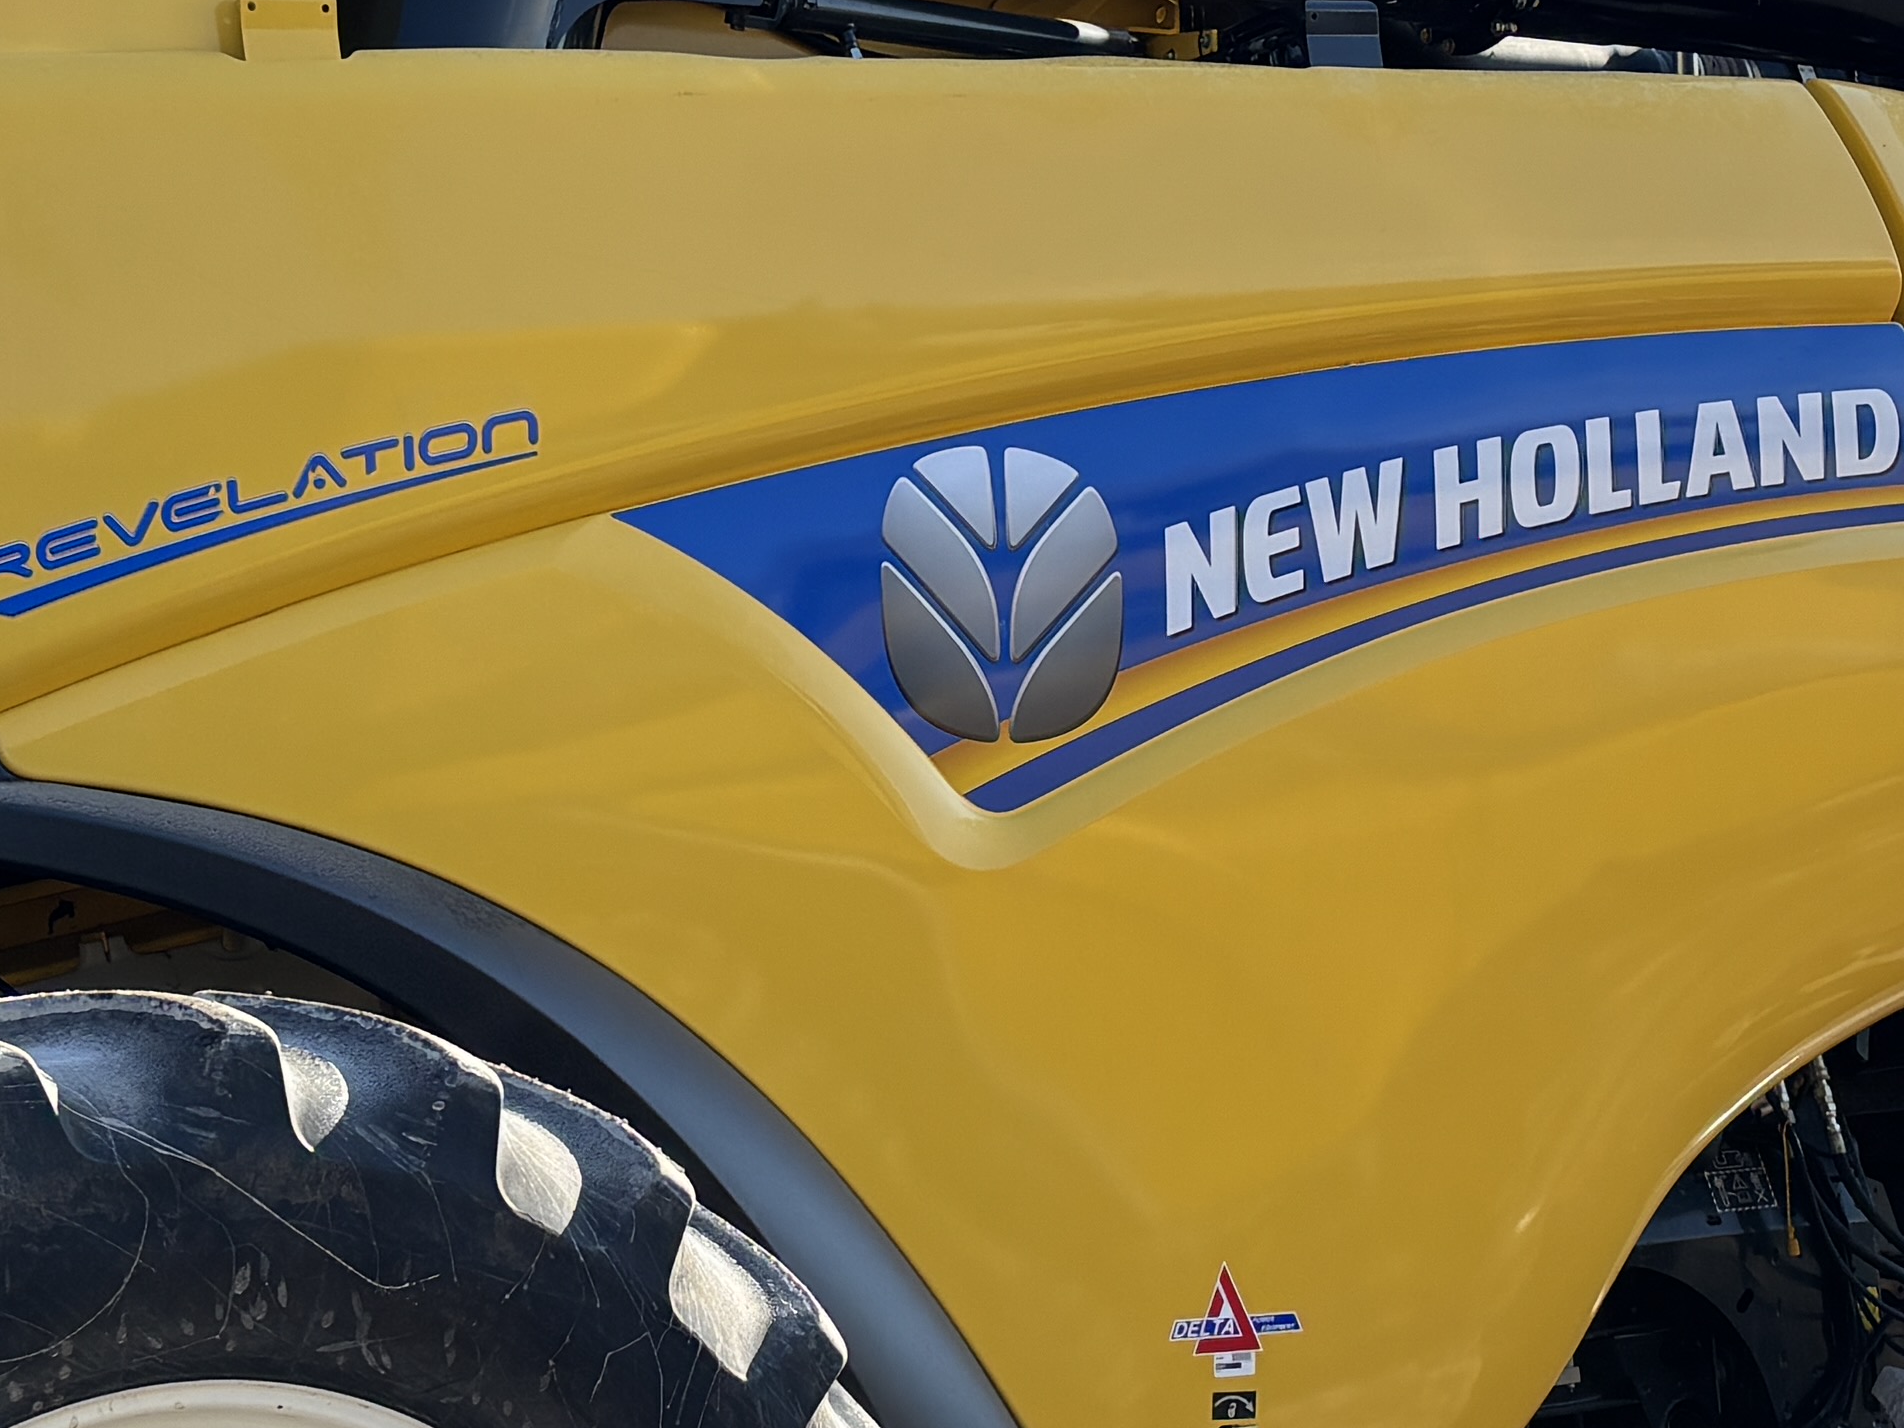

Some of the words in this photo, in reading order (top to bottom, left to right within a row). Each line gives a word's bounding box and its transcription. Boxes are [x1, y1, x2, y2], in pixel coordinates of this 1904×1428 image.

[1163, 456, 1404, 639] NEW
[1432, 387, 1903, 554] HOLLAND
[1172, 1318, 1236, 1338] DELTA
